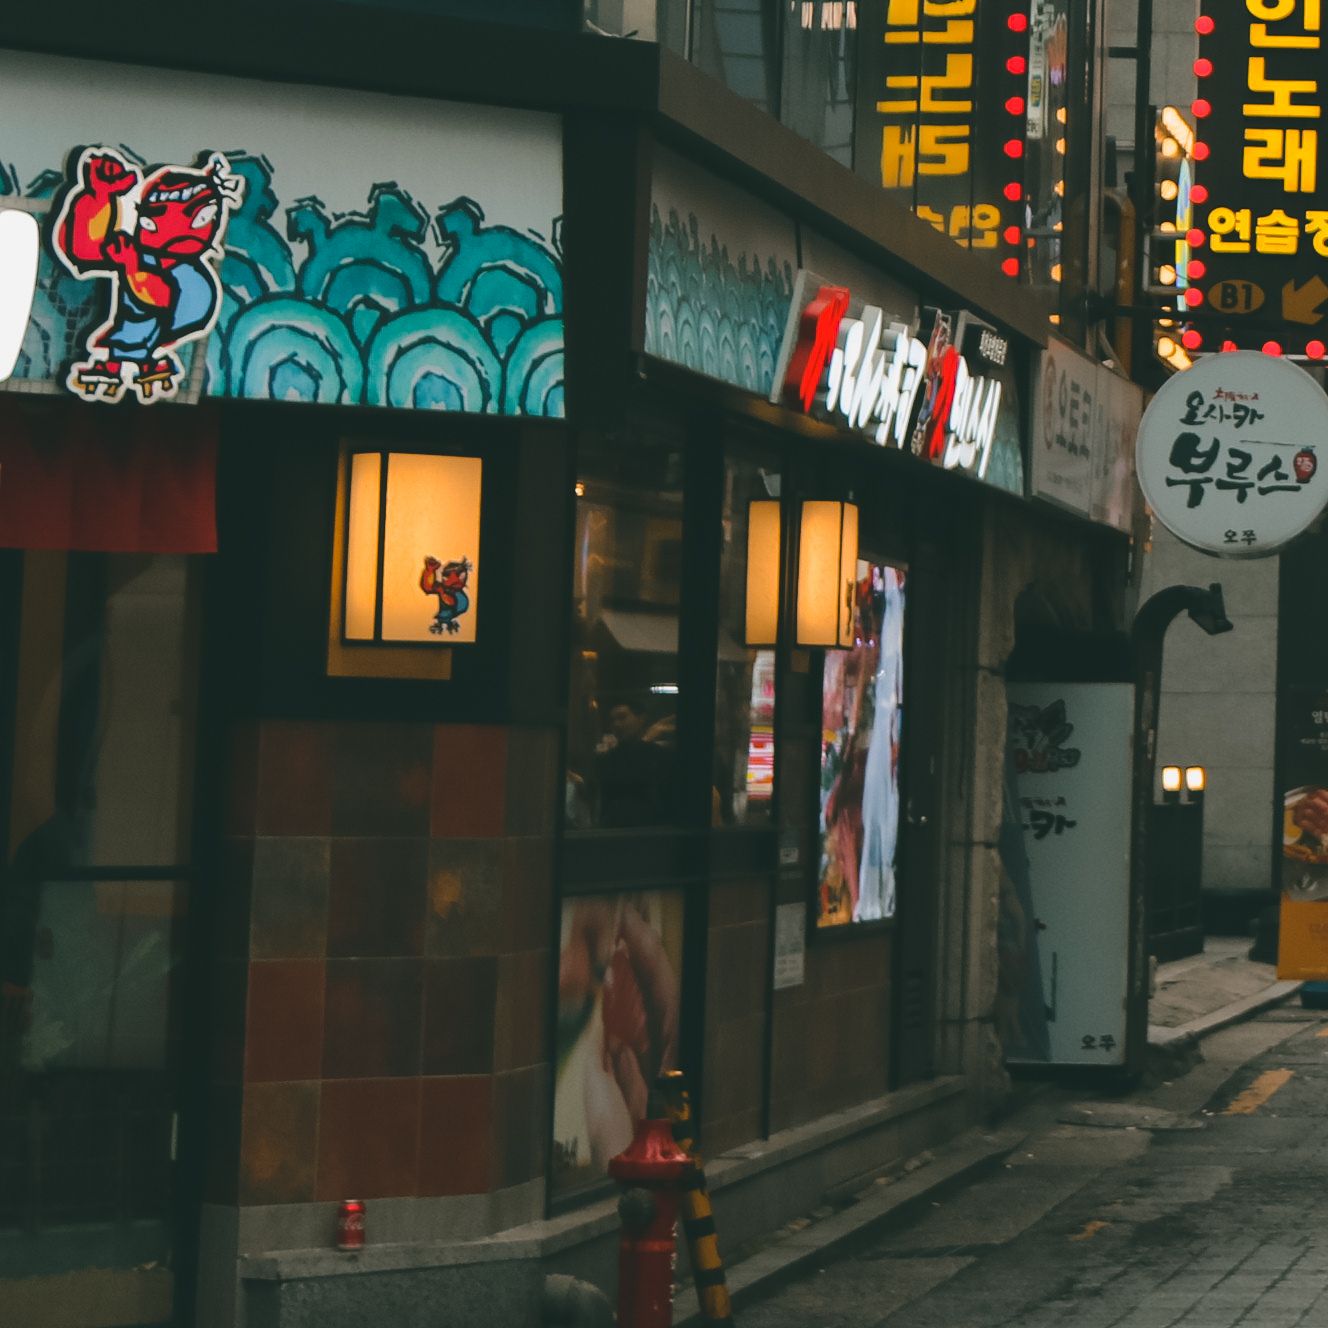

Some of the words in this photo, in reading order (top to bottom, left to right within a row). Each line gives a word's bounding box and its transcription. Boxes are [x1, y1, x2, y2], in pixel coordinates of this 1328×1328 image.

[1219, 282, 1253, 310] B1
[1179, 390, 1265, 429] 오사카
[1166, 432, 1302, 509] 부루스
